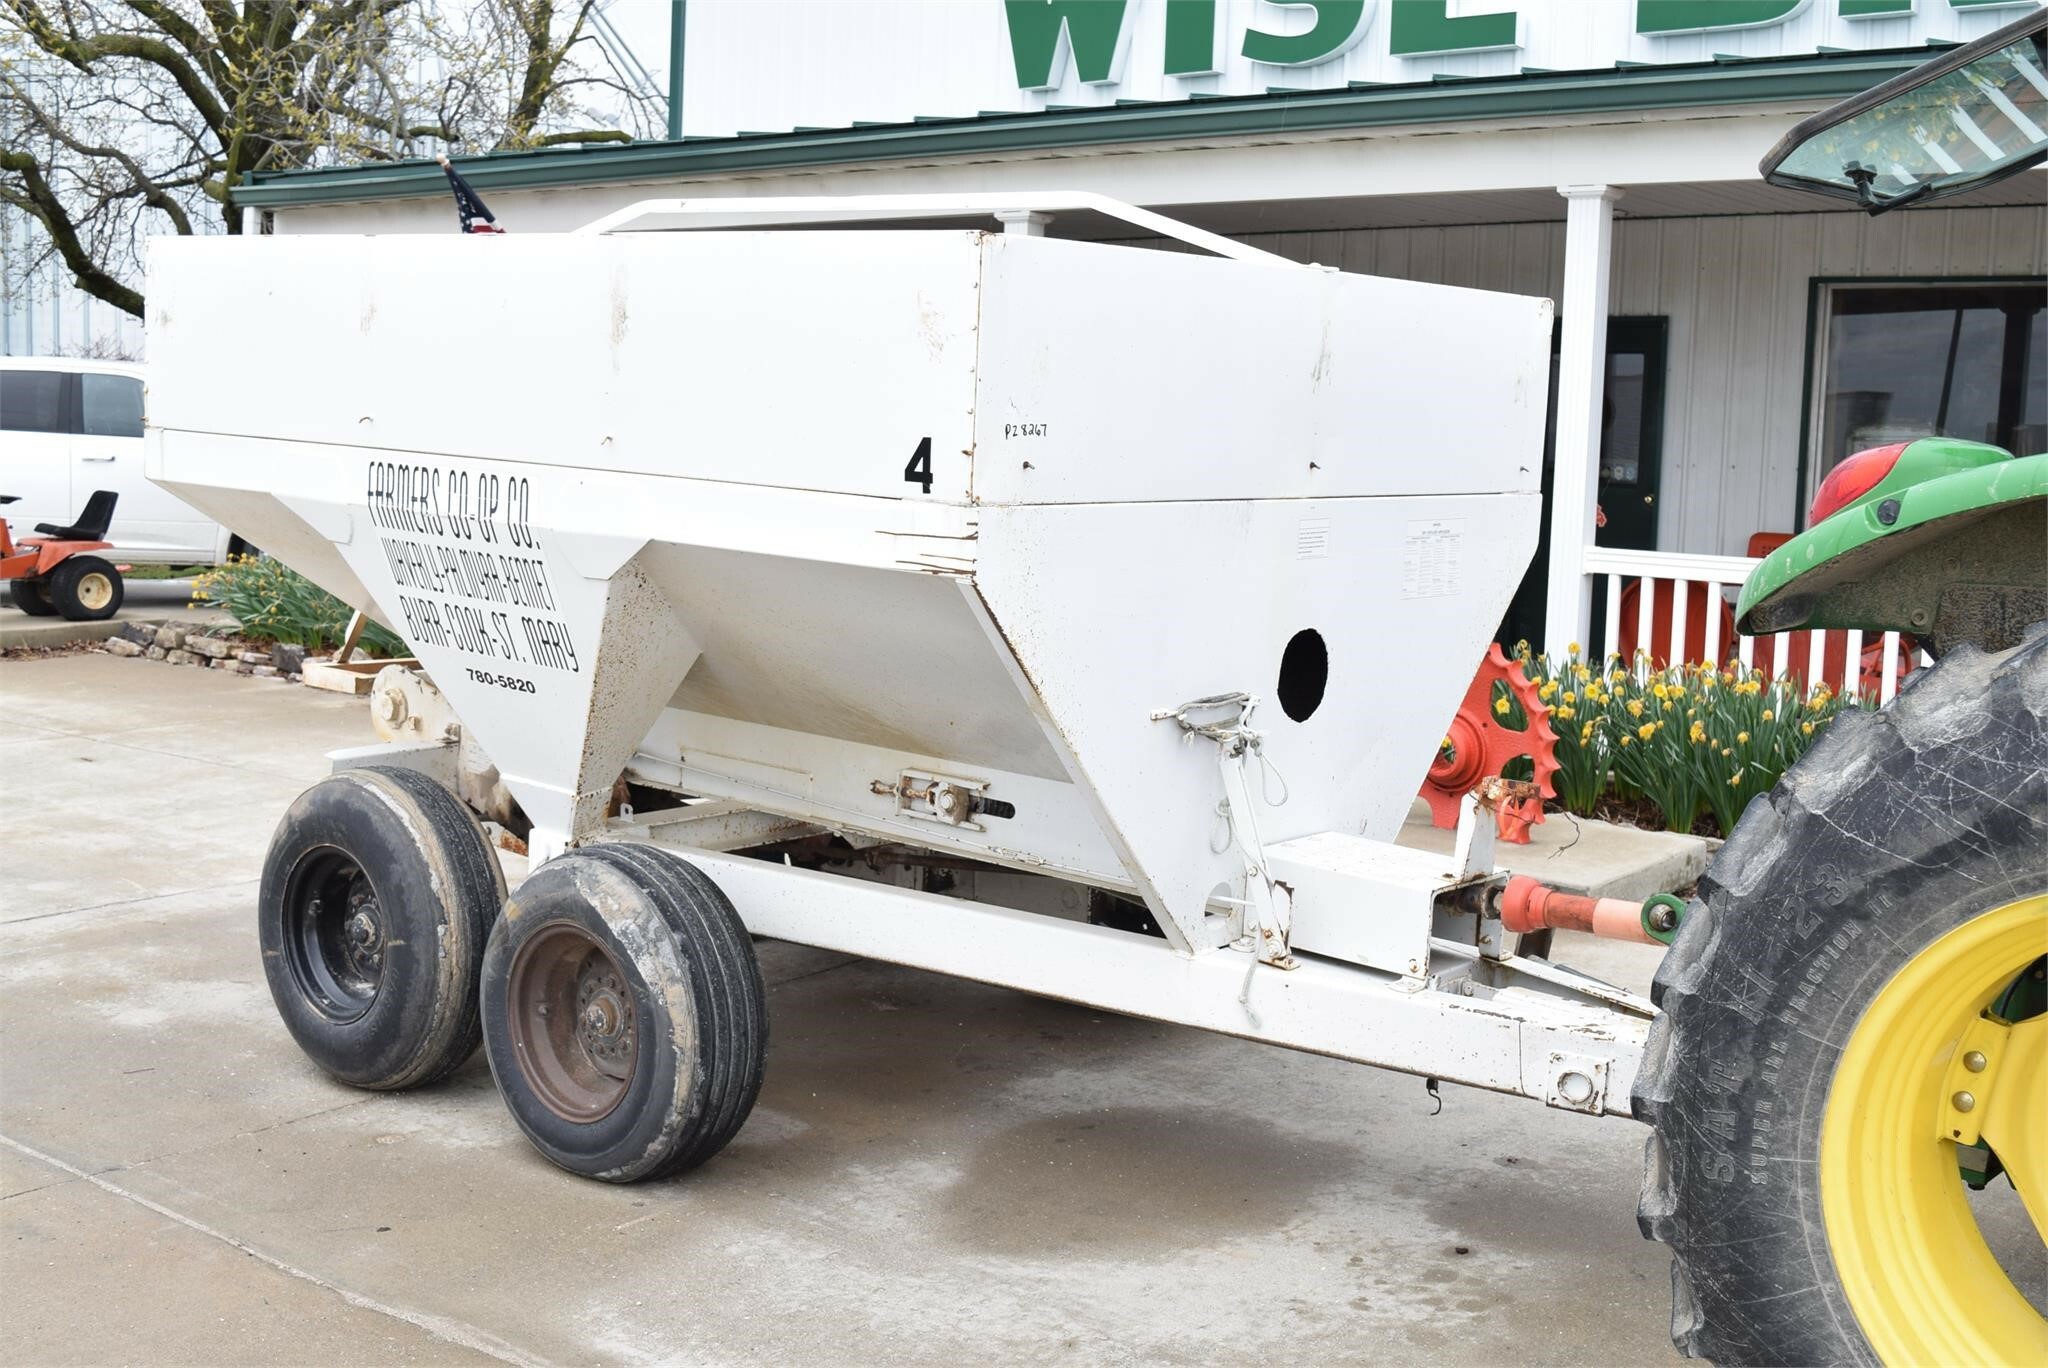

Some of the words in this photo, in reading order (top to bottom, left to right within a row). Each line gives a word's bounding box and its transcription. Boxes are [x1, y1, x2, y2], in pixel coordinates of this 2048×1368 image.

[904, 437, 934, 494] 4
[367, 461, 444, 536] FARMERS
[448, 470, 498, 544] CO-OP
[507, 477, 541, 549] CO.
[521, 616, 579, 673] MARY
[465, 668, 536, 694] 780-5820
[1780, 920, 1863, 1025] TRACTION
[1761, 1040, 1789, 1086] ALL
[1751, 1100, 1773, 1185] SUPER
